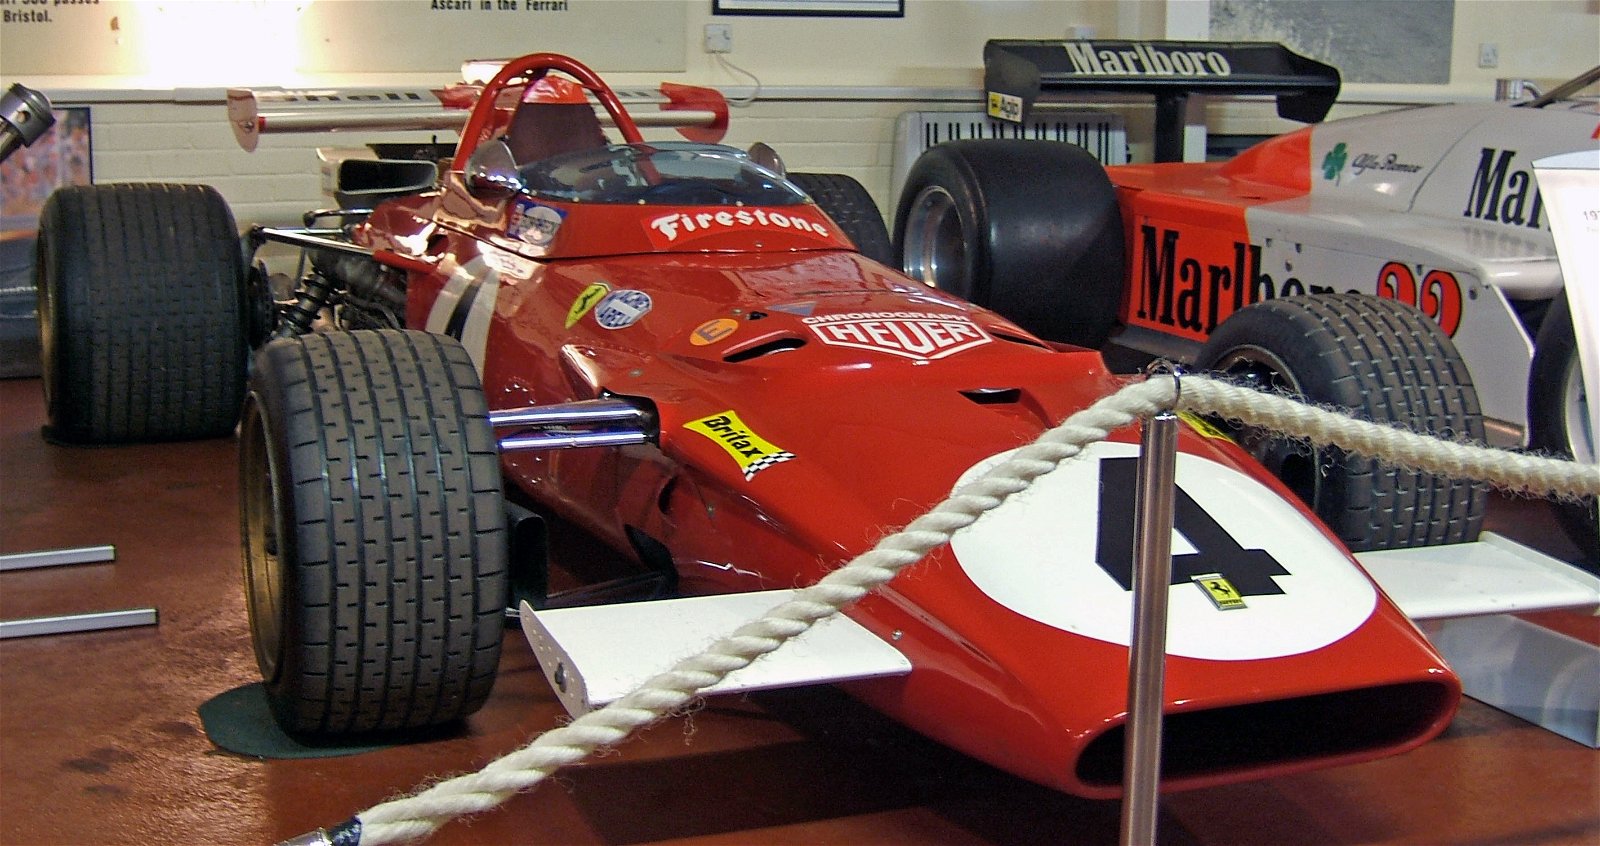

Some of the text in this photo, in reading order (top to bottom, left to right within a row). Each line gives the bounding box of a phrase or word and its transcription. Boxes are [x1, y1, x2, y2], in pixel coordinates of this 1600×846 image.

[3, 9, 52, 22] Bristol.
[431, 0, 568, 10] Ascari in the Ferrari
[1063, 43, 1231, 76] Marlboro
[651, 208, 829, 241] Firestone
[1583, 209, 1600, 221] 19
[1137, 225, 1361, 335] Marlb
[696, 320, 733, 342] E
[801, 311, 973, 325] CHRONOGRAPH
[828, 321, 979, 354] HEUER
[702, 416, 764, 458] Britax
[1095, 457, 1292, 596] 4
